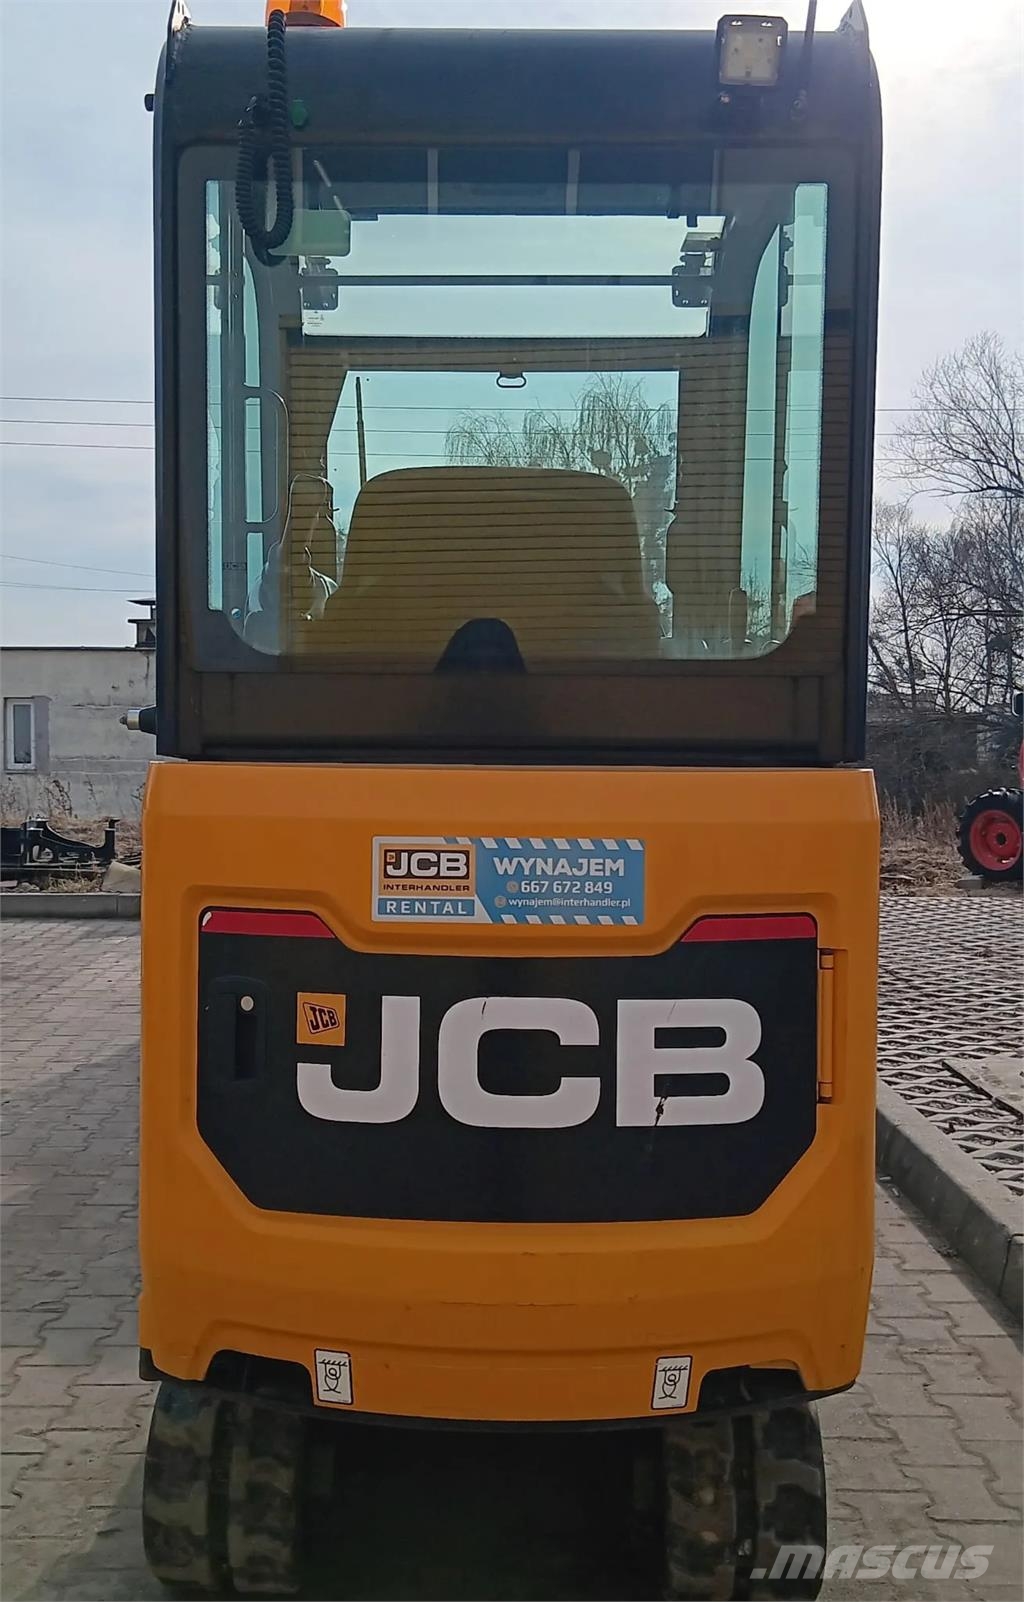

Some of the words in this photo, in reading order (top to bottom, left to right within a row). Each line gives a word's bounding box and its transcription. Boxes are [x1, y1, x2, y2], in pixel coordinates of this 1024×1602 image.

[386, 852, 467, 877] JCB
[493, 857, 625, 876] WYNAJEM
[383, 884, 470, 892] INTERHANDLER
[521, 881, 549, 893] 667
[553, 881, 581, 893] 672
[584, 881, 613, 894] 849
[386, 900, 468, 914] RENTAL
[508, 897, 631, 908] wynajem@interhandler.pl
[308, 1005, 338, 1031] JCB
[296, 995, 766, 1128] JCB
